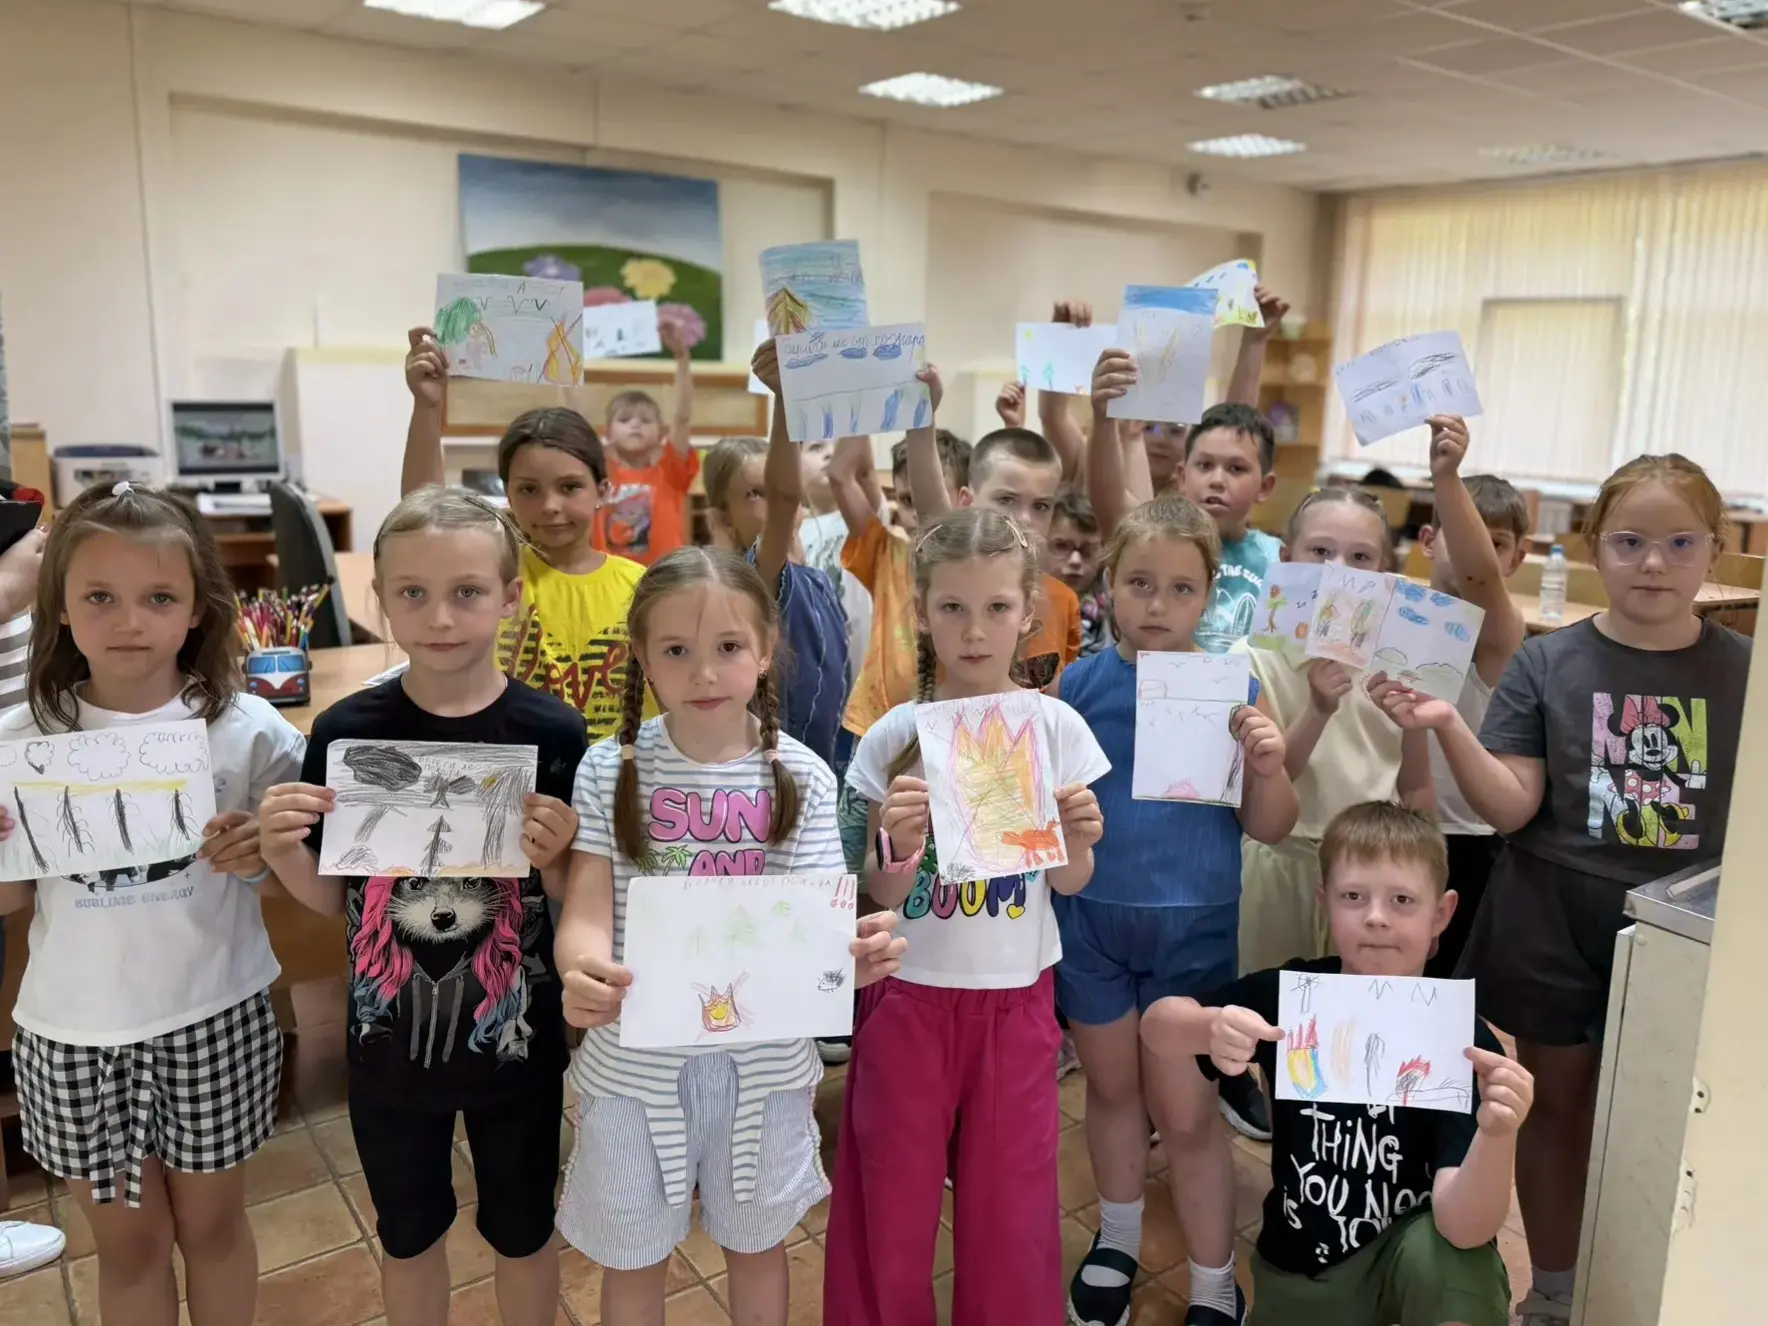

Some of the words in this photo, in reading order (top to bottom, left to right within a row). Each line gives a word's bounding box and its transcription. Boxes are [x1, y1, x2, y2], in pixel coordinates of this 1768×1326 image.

[648, 786, 773, 844] SUN
[687, 848, 766, 876] AND
[74, 894, 136, 909] SUBLIME
[1290, 1153, 1350, 1216] YOU
